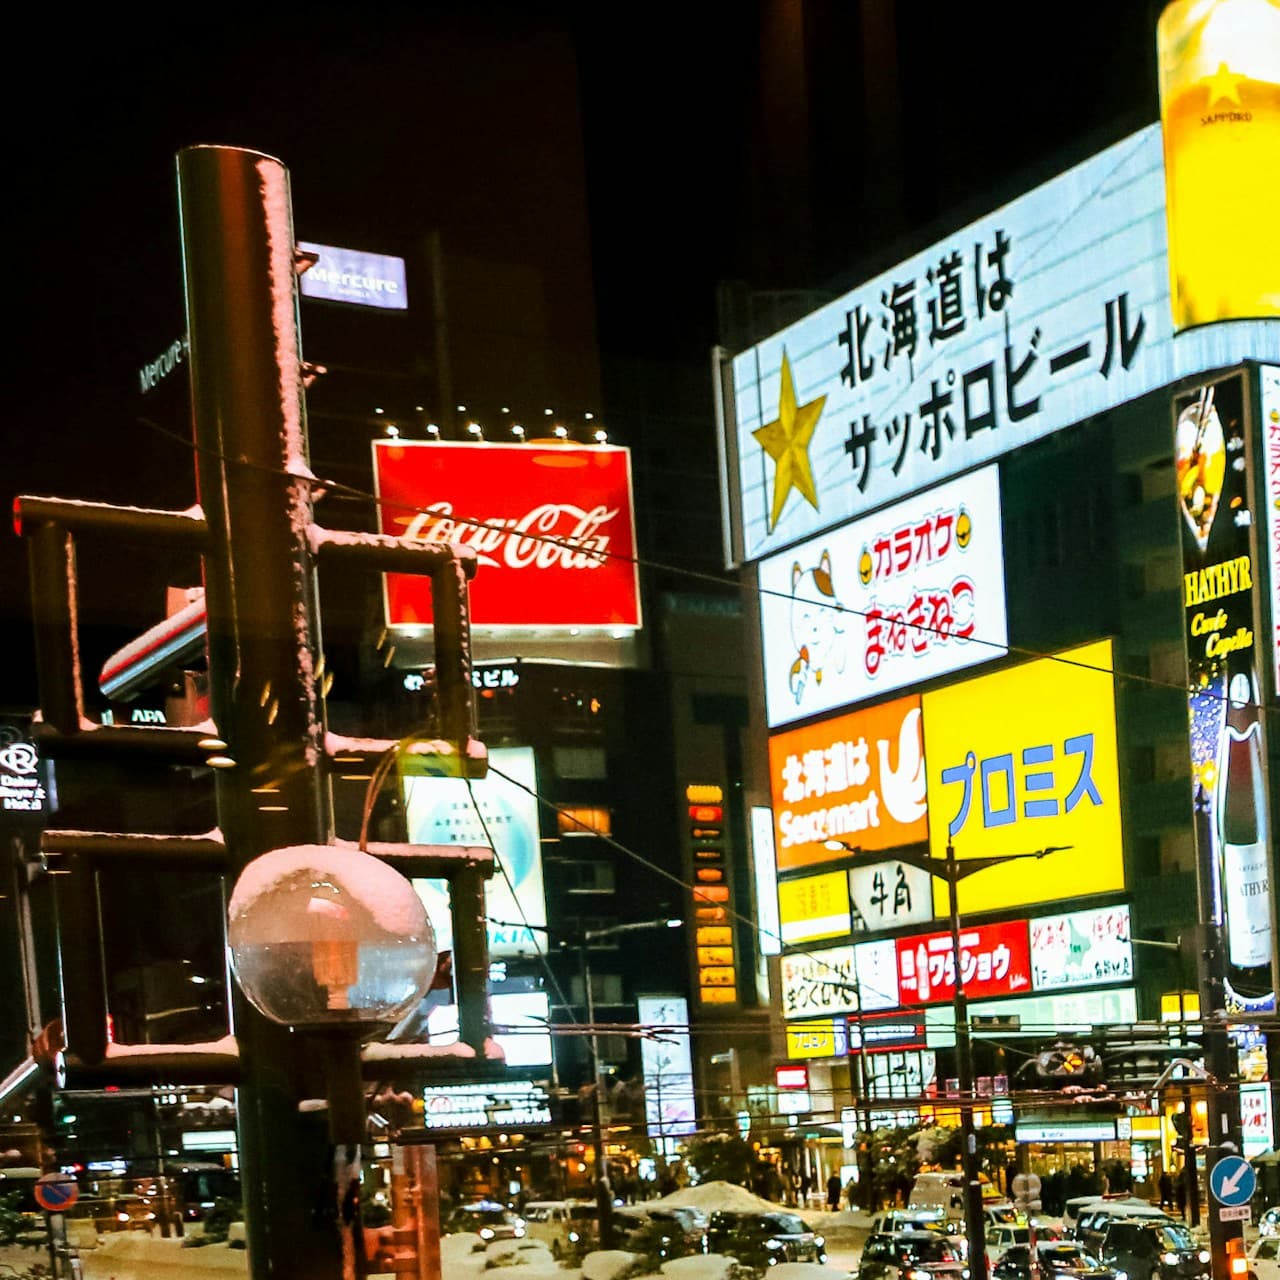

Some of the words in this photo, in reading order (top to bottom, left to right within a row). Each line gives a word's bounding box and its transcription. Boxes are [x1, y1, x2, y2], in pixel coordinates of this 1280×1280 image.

[308, 266, 398, 294] Mercure
[838, 229, 1014, 389] 北海道は
[845, 291, 1146, 493] サッポロビール
[873, 514, 953, 579] カラオケ
[1184, 556, 1253, 607] HATHYR
[865, 581, 975, 674] まねきねこ
[941, 733, 1103, 837] プロミス
[870, 864, 912, 915] 牛角
